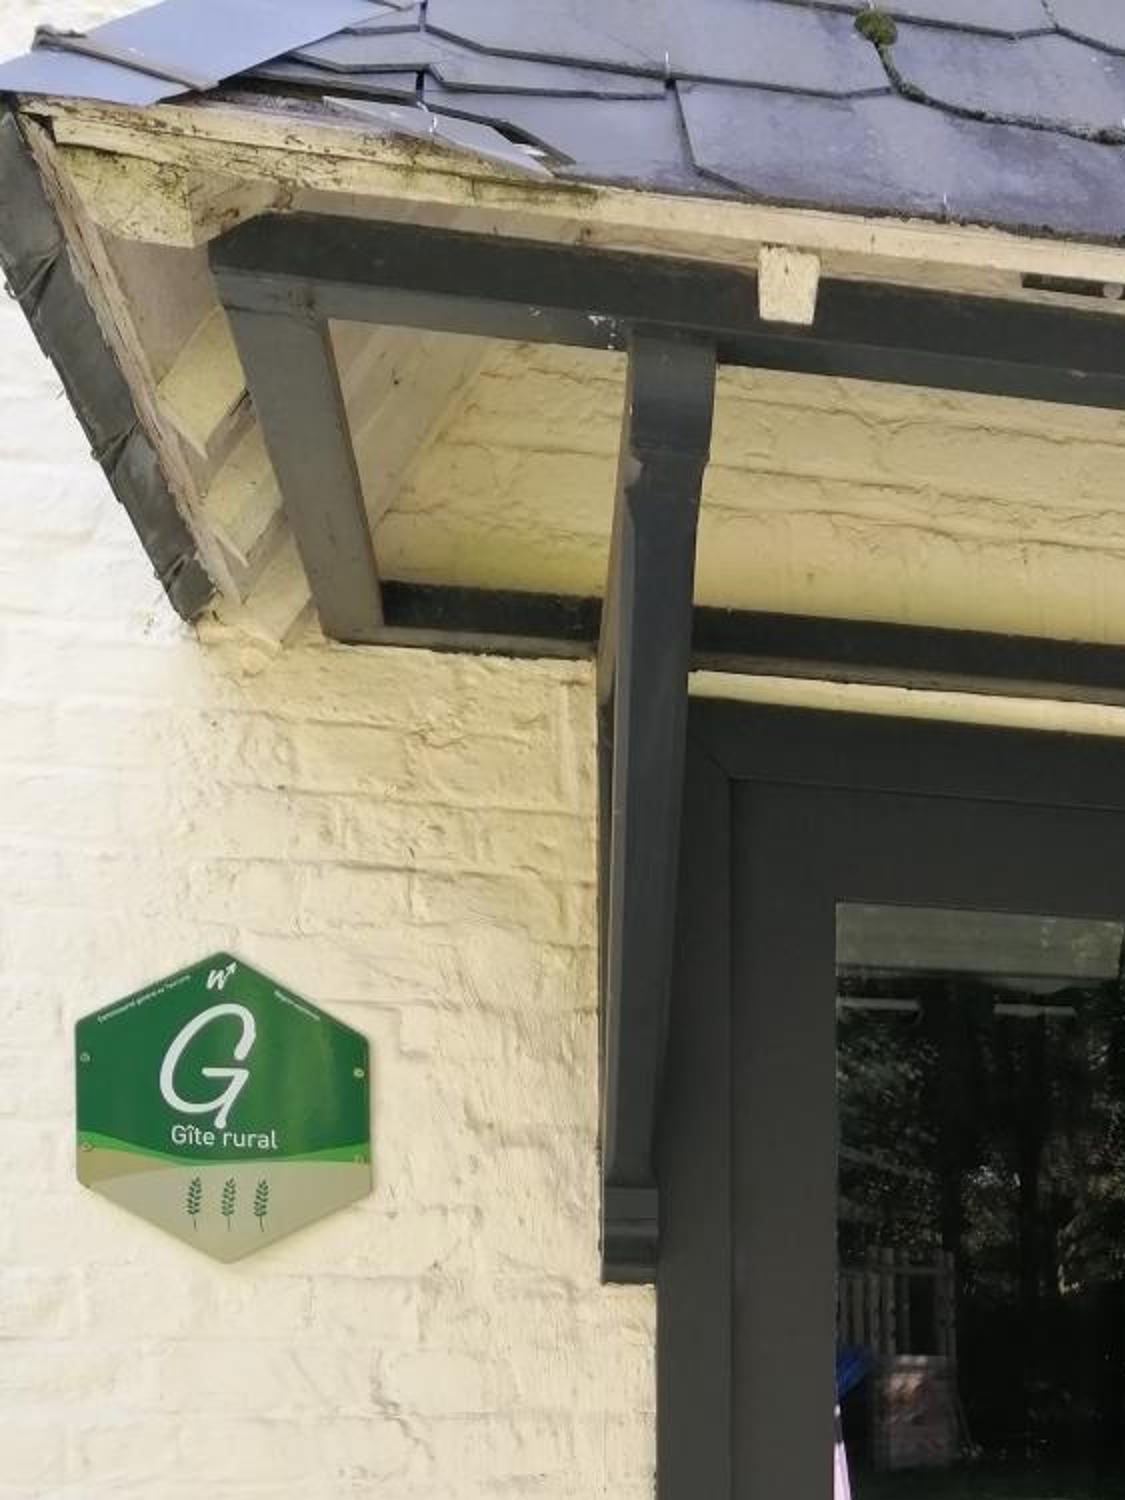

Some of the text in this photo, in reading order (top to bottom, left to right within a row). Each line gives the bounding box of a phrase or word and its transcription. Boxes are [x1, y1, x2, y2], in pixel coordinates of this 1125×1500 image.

[159, 1003, 256, 1129] G
[171, 1124, 279, 1150] Gîte rural
